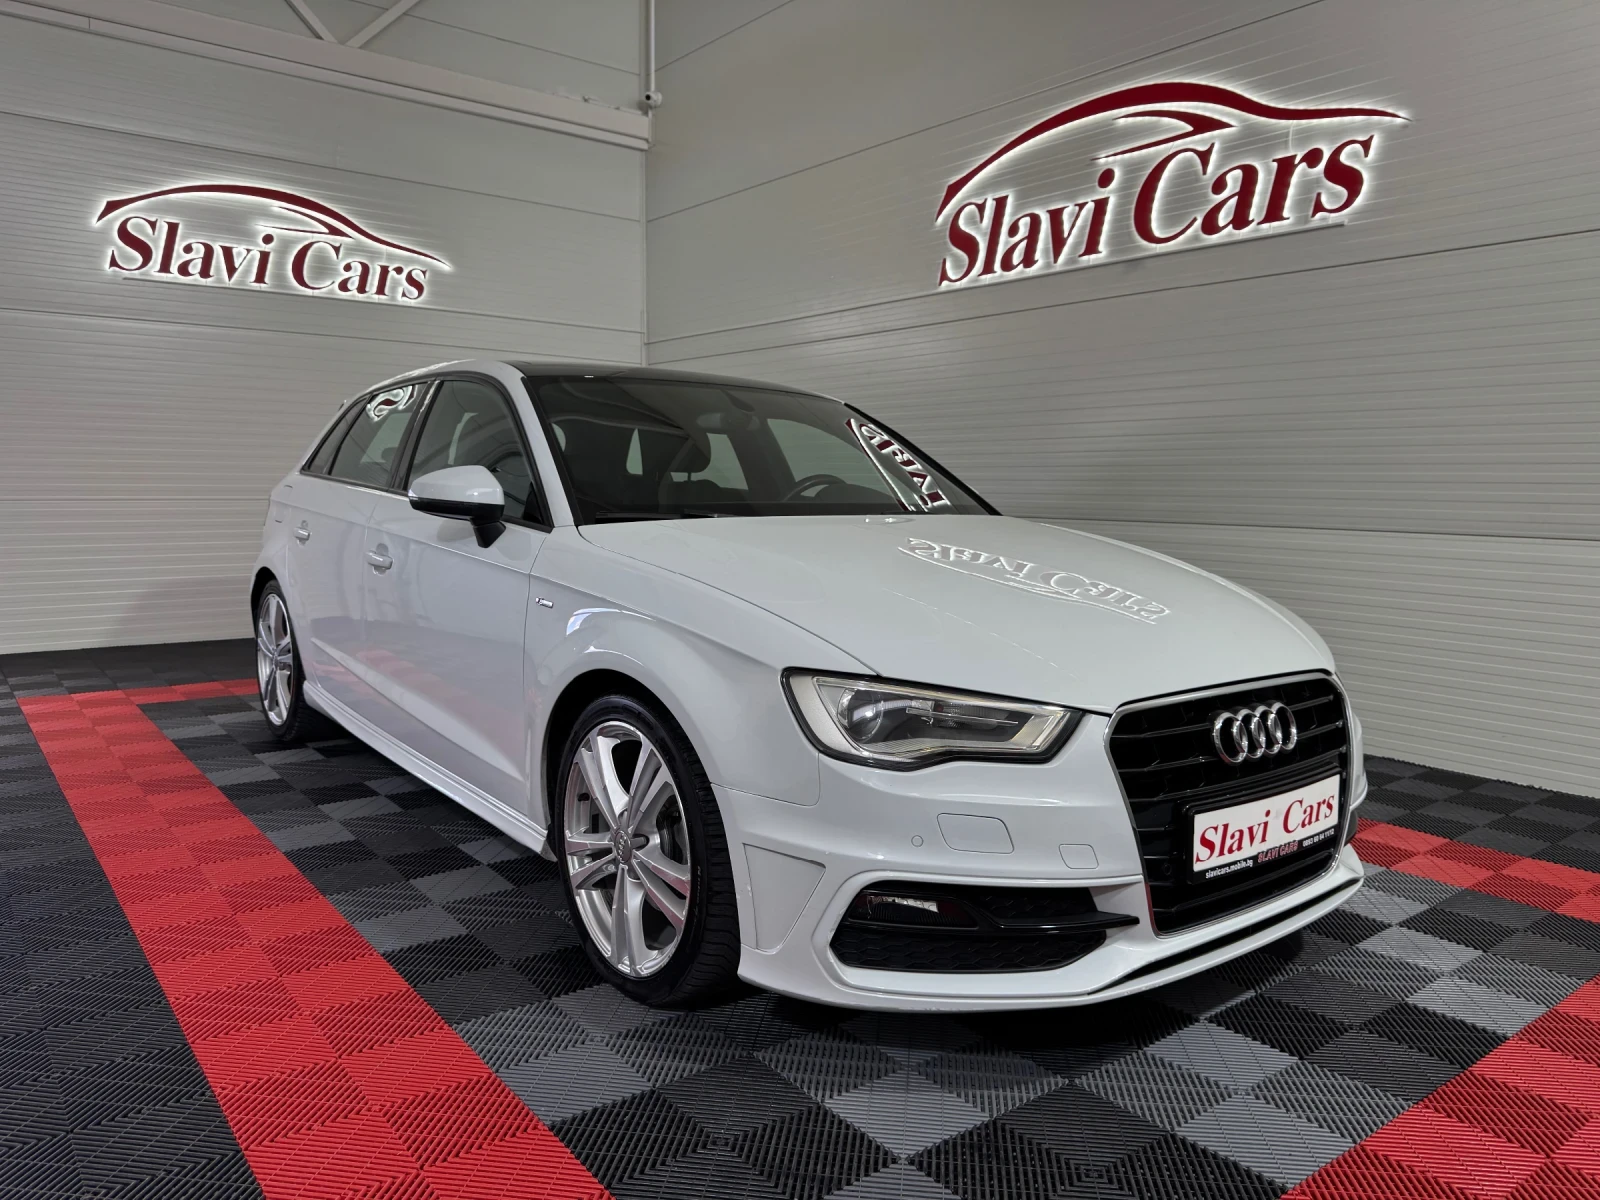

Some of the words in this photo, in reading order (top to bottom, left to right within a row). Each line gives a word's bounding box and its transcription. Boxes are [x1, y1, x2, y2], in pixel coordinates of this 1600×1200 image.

[939, 167, 1115, 287] Slavi
[1133, 134, 1374, 244] Cars
[109, 215, 273, 285] Slavi
[290, 240, 428, 300] Cars
[1195, 809, 1271, 864] Slavi
[1282, 795, 1335, 834] Cars
[1257, 847, 1279, 863] SLAVI
[1279, 840, 1299, 856] CARS
[1205, 859, 1253, 879] slavicars.mobile.bg
